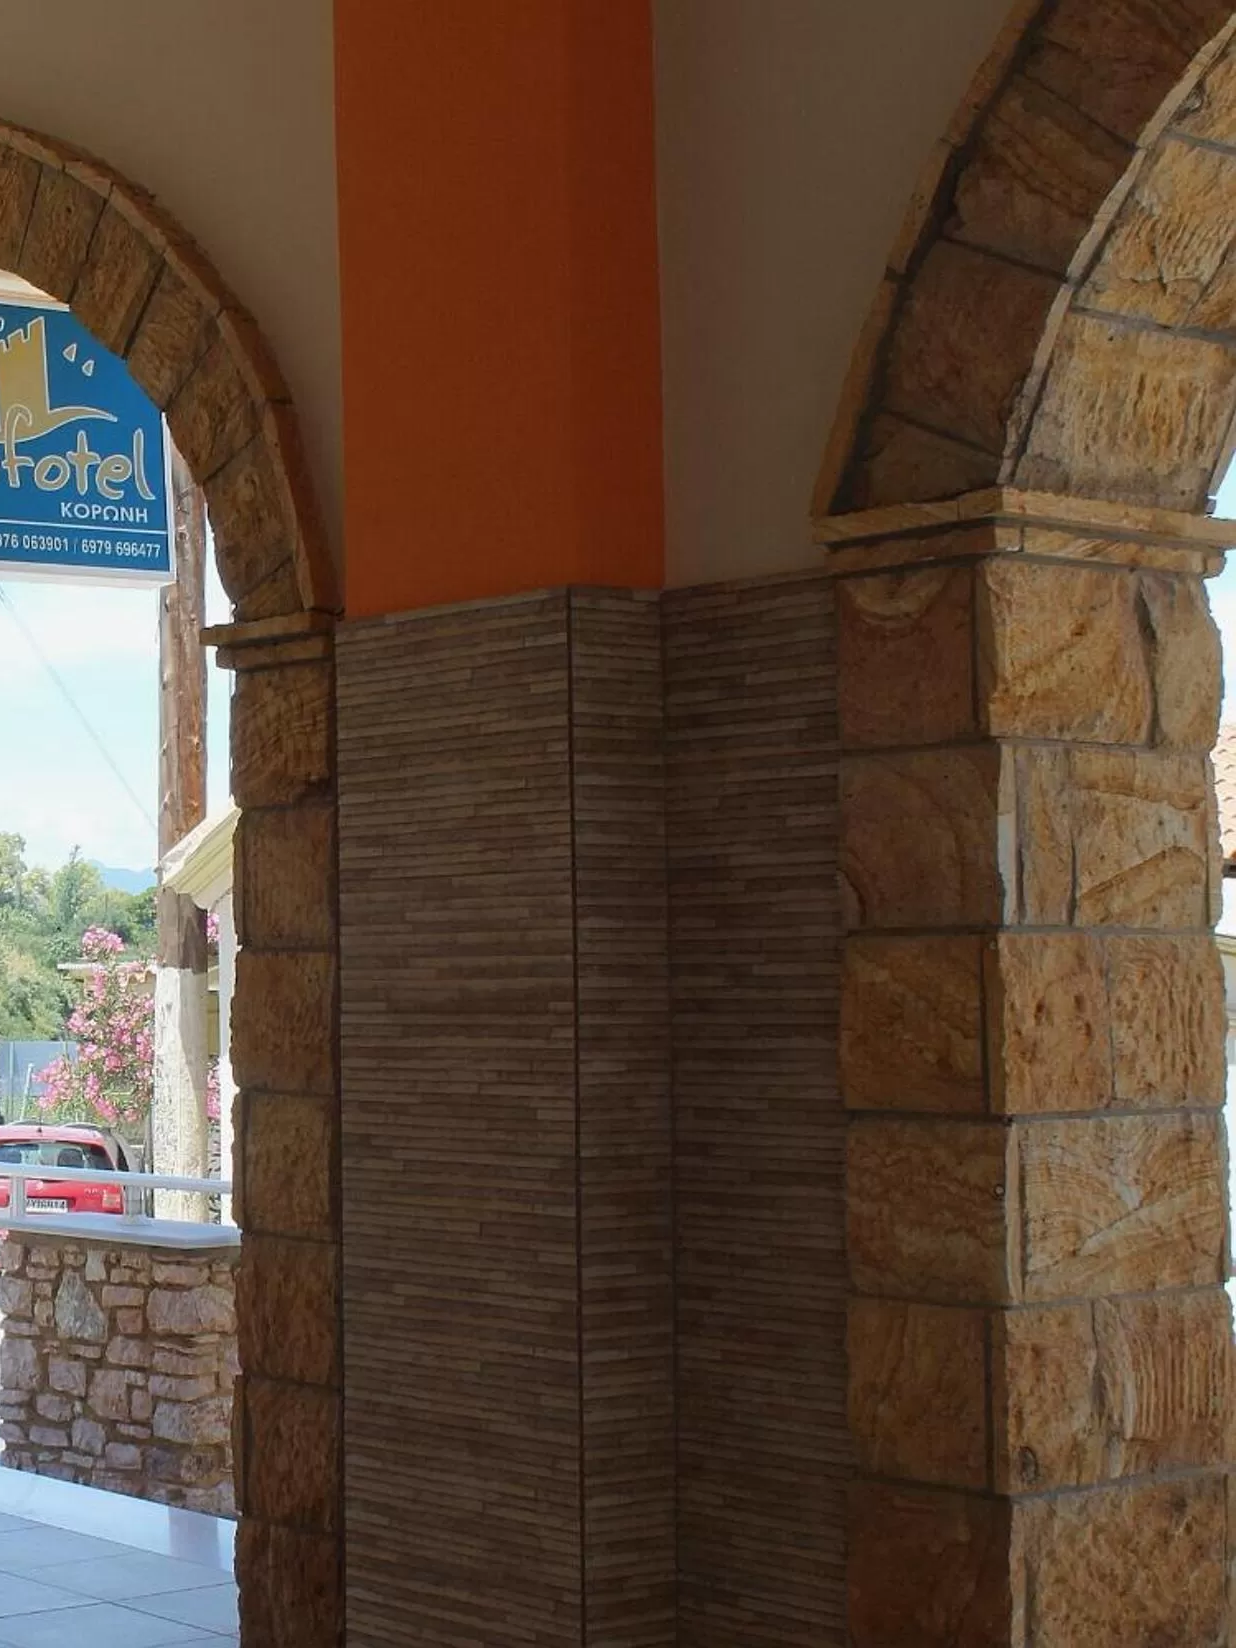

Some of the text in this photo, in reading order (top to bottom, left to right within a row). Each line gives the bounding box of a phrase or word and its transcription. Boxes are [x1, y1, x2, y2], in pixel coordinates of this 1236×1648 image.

[60, 502, 148, 523] ΚΟΡΩΝΗ
[22, 535, 69, 552] 063901
[81, 539, 112, 555] 6979
[115, 541, 161, 558] 696477
